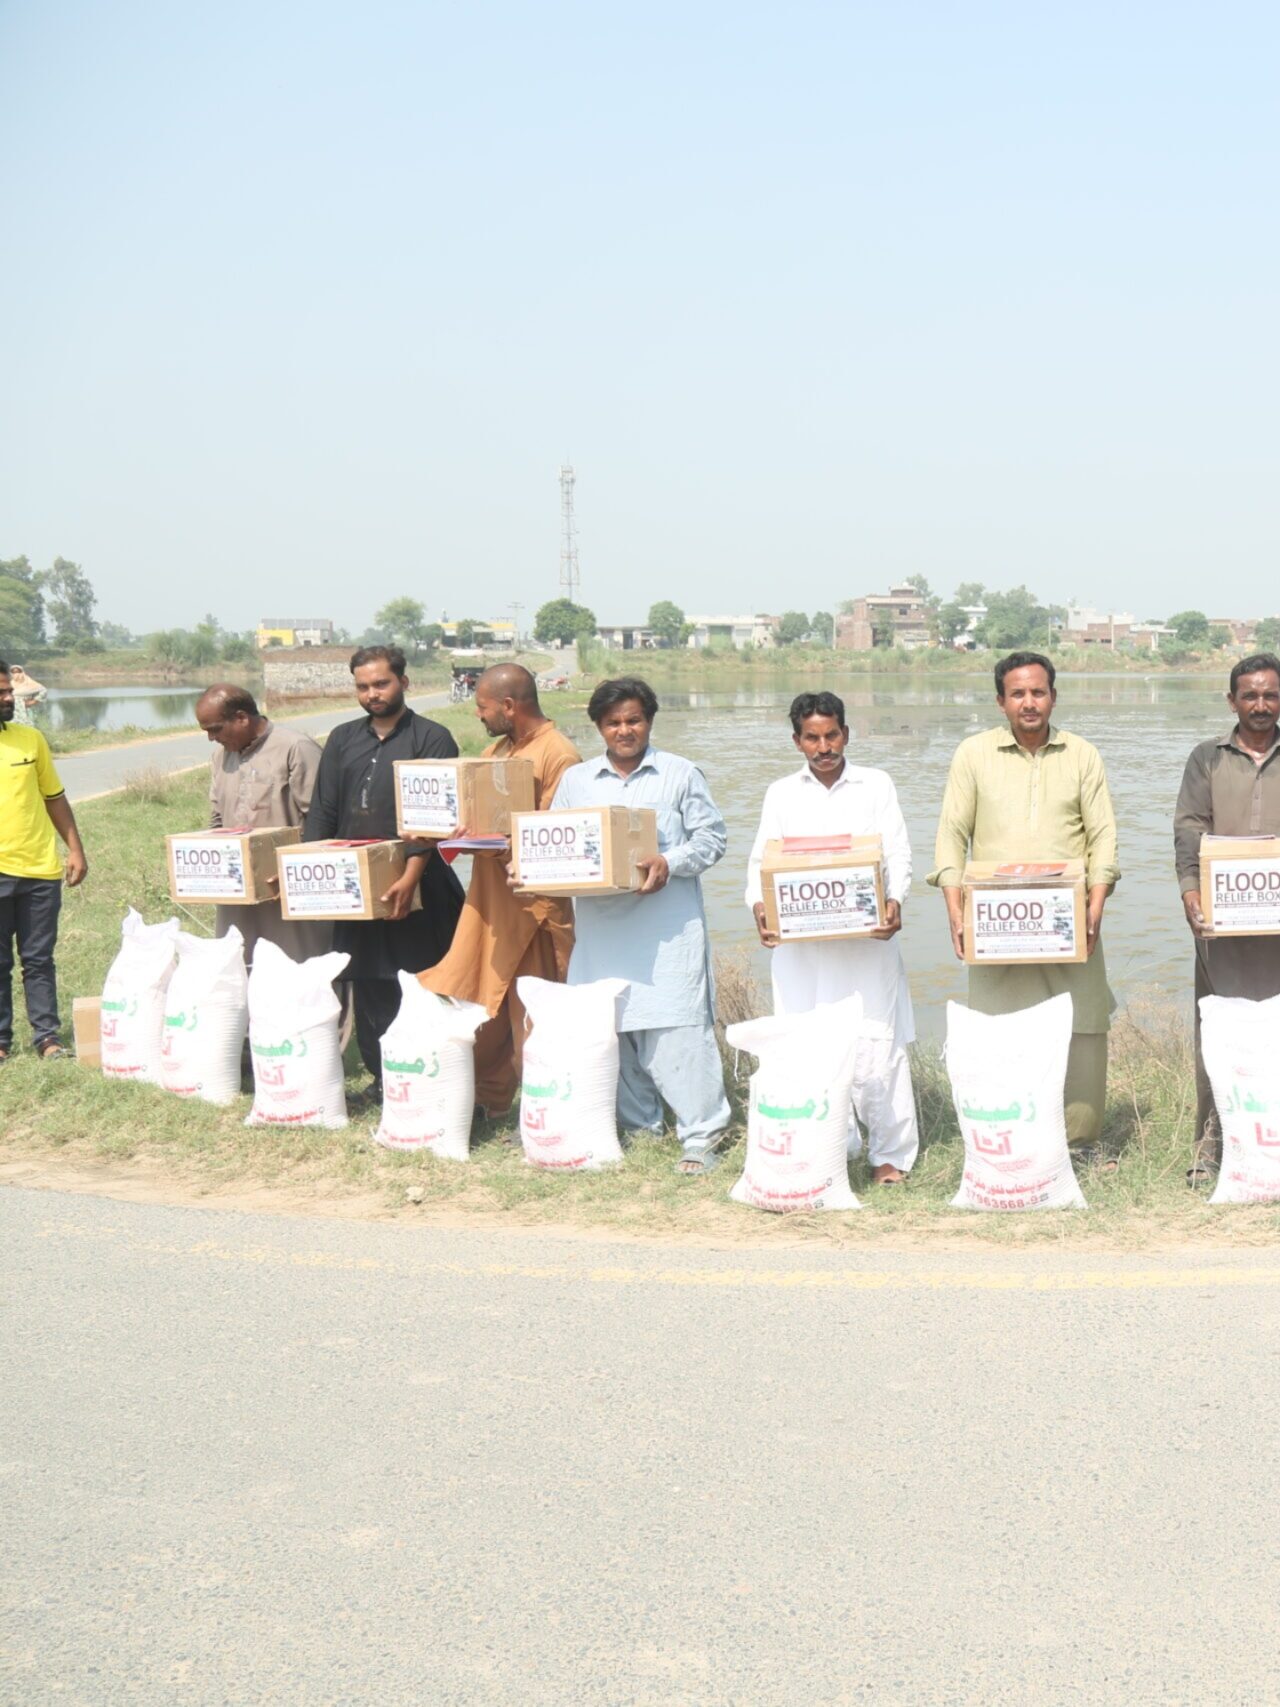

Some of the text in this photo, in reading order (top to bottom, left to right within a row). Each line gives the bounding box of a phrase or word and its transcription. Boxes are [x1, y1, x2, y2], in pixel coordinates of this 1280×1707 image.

[402, 777, 439, 795] FLOOD
[521, 826, 576, 847] FLOOD
[176, 849, 221, 865] FLOOD
[522, 846, 576, 857] RELIEF BOX
[286, 864, 336, 882] FLOOD
[779, 881, 846, 903] FLOOD
[1216, 891, 1253, 903] RELIEF
[781, 899, 847, 913] RELIEF BOX
[976, 902, 1044, 921] FLOOD
[977, 921, 1044, 931] RELIEF BOX
[972, 1128, 1013, 1156] آٹا
